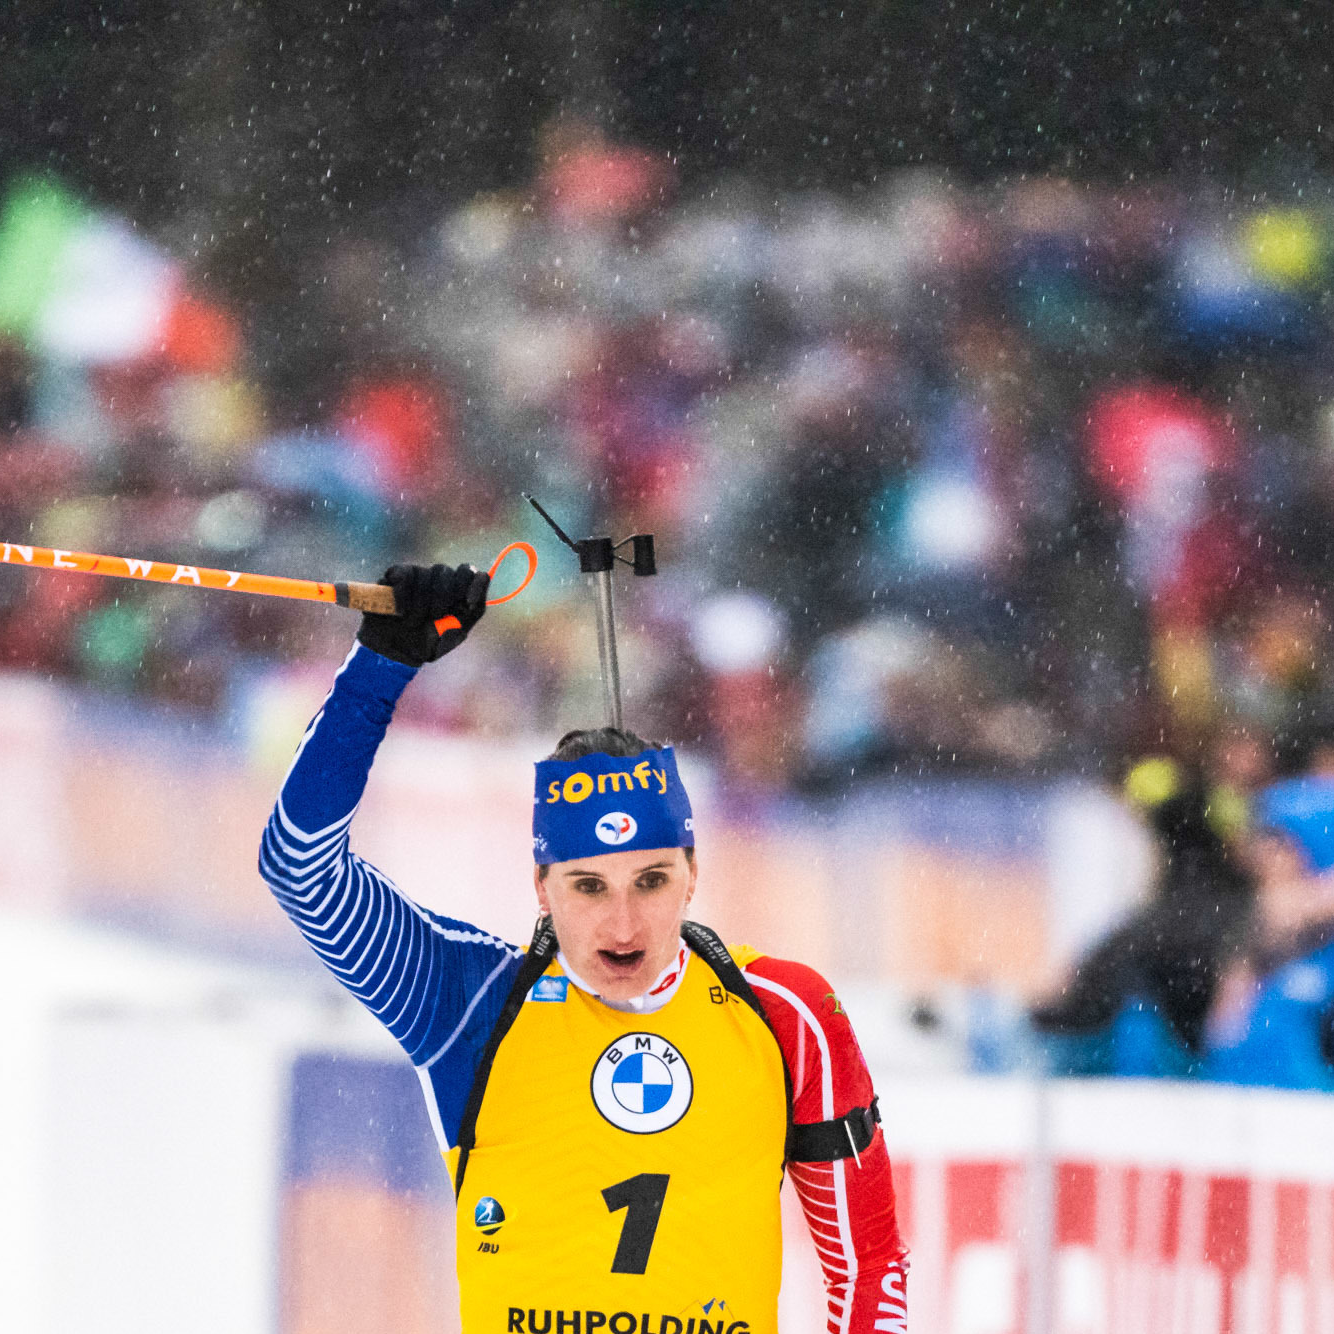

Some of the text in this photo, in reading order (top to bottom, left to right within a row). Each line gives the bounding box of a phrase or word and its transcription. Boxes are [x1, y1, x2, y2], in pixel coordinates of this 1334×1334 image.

[546, 760, 667, 804] somfy
[606, 1036, 679, 1065] BMW
[600, 1172, 671, 1275] 1
[477, 1241, 500, 1254] IBU
